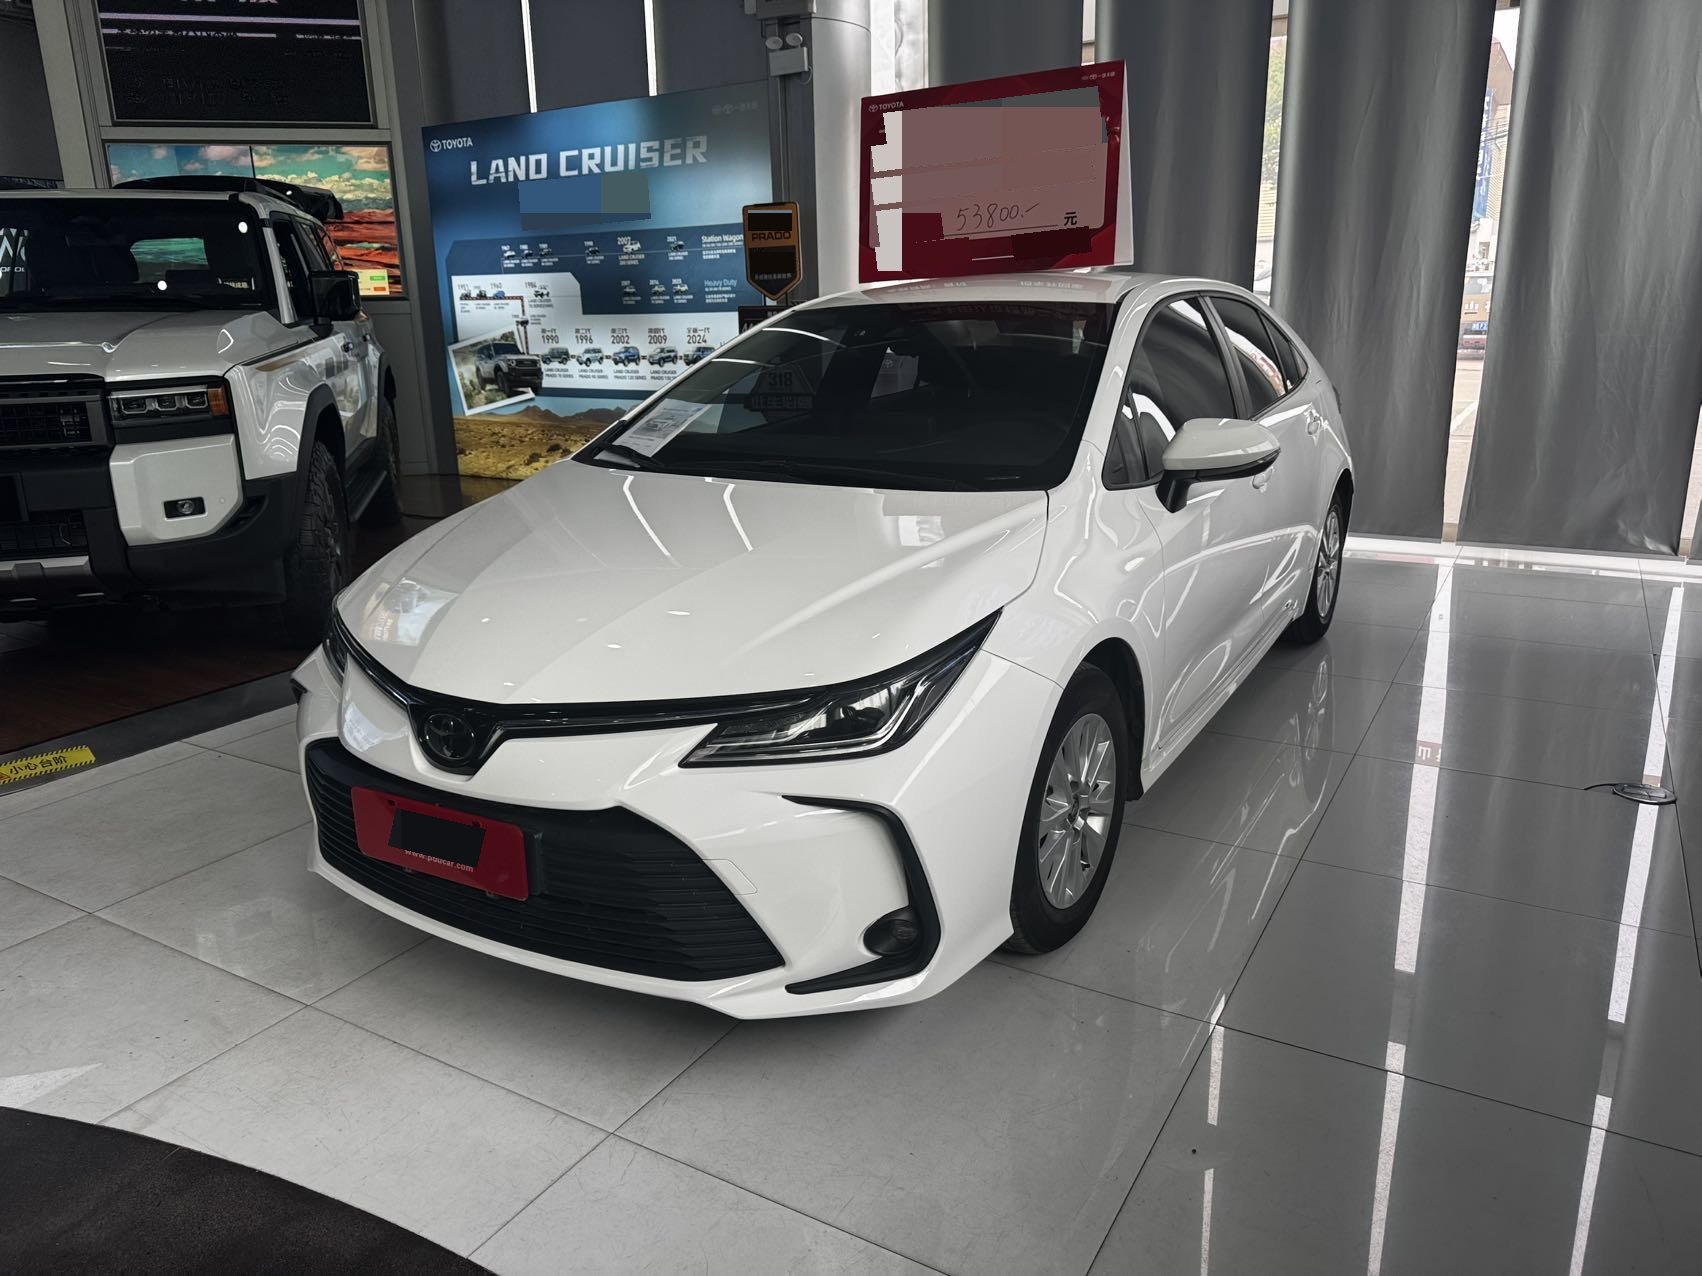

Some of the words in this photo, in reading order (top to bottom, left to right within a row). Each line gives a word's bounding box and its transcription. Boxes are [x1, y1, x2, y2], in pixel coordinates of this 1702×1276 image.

[879, 101, 904, 110] TOYOTA
[442, 137, 473, 150] TOYOTA
[470, 153, 547, 185] LAND
[559, 135, 708, 177] CRUISER
[1063, 211, 1078, 227] 元
[701, 235, 722, 243] Station
[723, 233, 744, 243] Wagon
[751, 231, 791, 241] PRADO
[723, 278, 738, 287] Duty
[541, 335, 559, 344] 1990
[575, 335, 593, 344] 1996
[611, 335, 630, 345] 2002
[648, 335, 668, 344] 2009
[687, 334, 707, 345] 2024
[10, 755, 67, 774] 小心台阶
